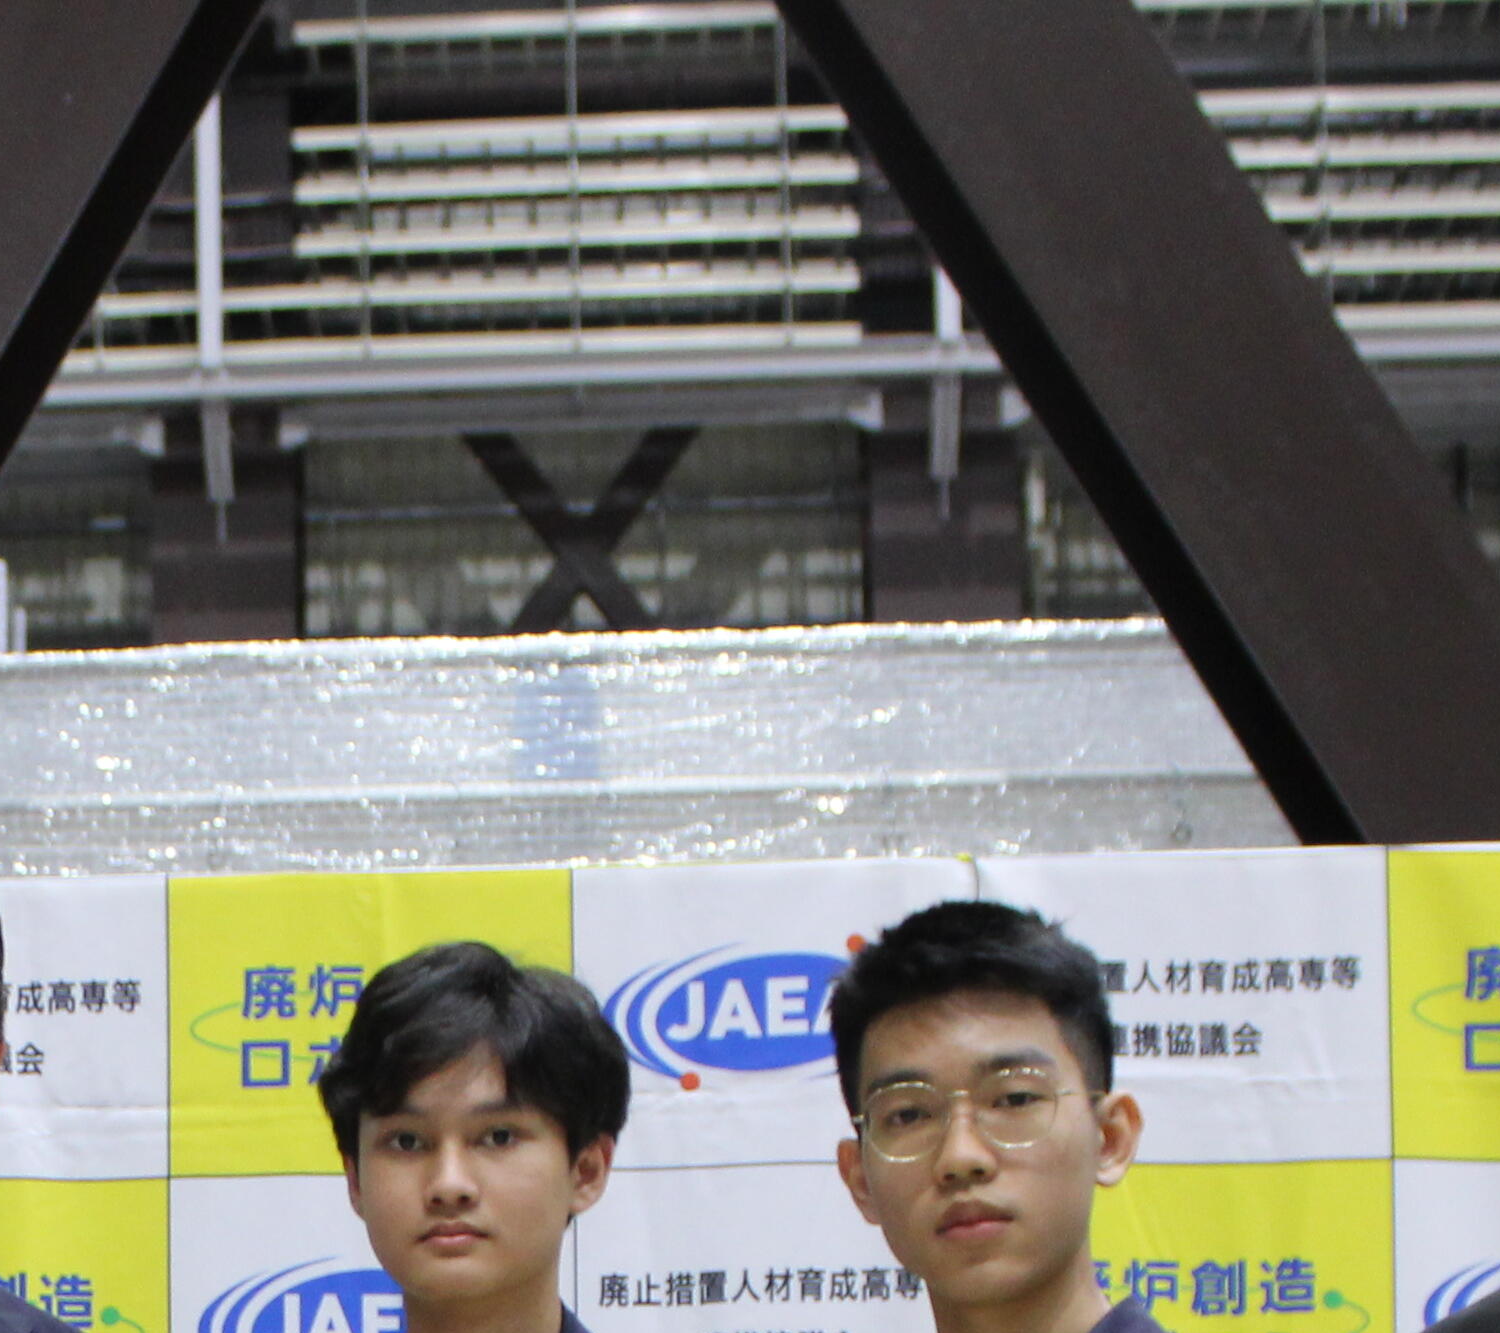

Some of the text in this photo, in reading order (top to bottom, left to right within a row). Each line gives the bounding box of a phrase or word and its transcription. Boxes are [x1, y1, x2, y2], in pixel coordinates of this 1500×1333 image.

[1, 979, 141, 1015] 成高専等
[1092, 1258, 1316, 1316] 炉創造
